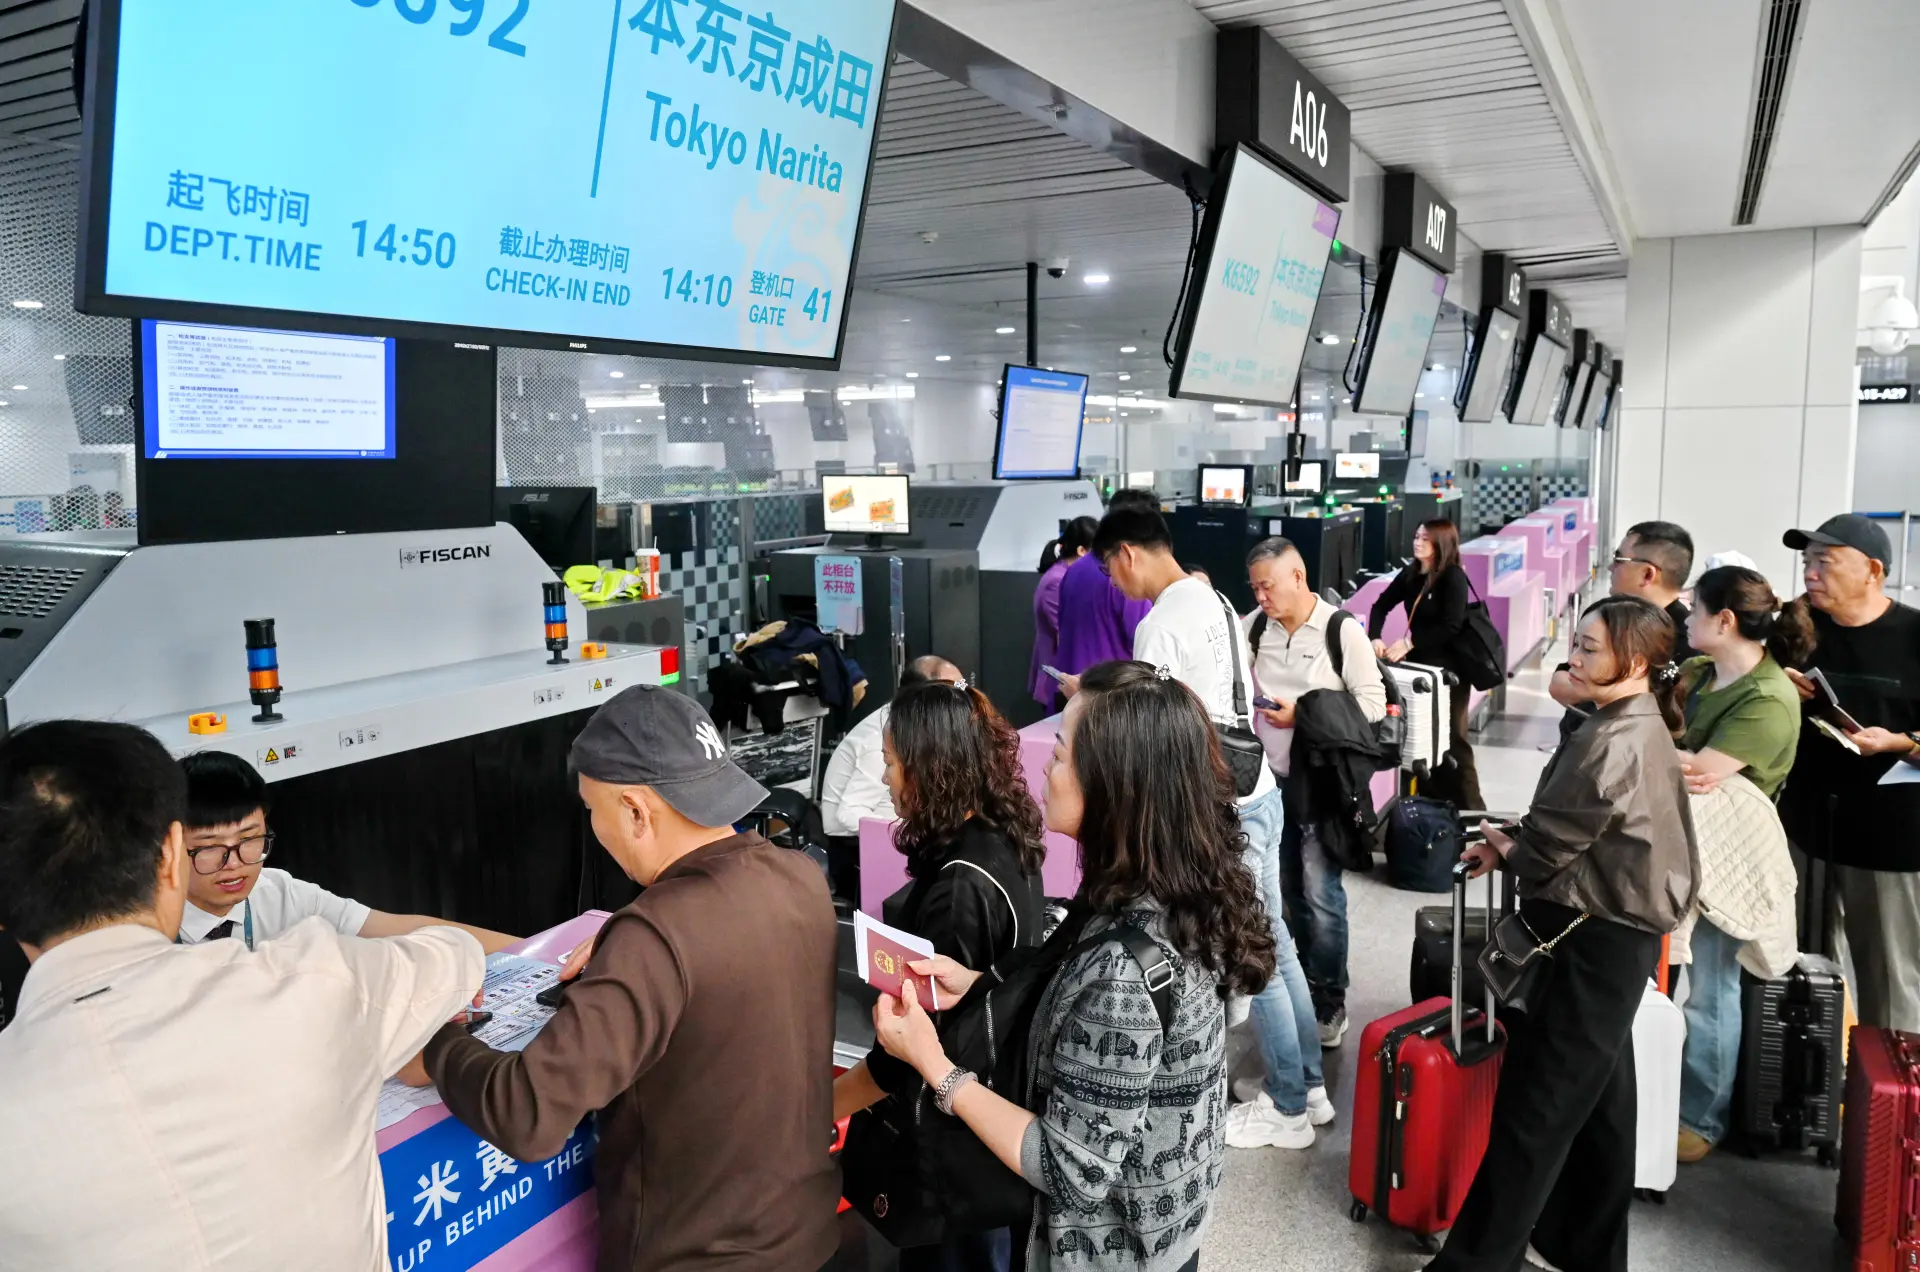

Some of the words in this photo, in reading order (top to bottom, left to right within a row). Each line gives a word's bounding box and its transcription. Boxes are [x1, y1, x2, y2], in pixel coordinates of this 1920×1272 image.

[646, 90, 747, 170] Tokyo
[756, 127, 843, 193] Narita
[1289, 79, 1329, 168] A06
[166, 169, 310, 227] 起飞时间
[144, 221, 322, 271] DEPT.TIME
[351, 219, 457, 269] 14:50
[1425, 201, 1447, 254] A07
[499, 225, 630, 274] 截止办理时间
[486, 266, 588, 302] CHECK-IN
[592, 282, 631, 307] END
[661, 266, 733, 308] 14:10
[749, 270, 795, 299] 登机口
[1222, 257, 1261, 296] K6592
[749, 304, 787, 327] GATE
[803, 286, 832, 323] 41
[522, 493, 550, 502] ASUS
[420, 545, 490, 563] FISCAN
[823, 563, 854, 578] 此柜台
[823, 580, 856, 594] 不开放
[397, 1238, 432, 1272] UP
[445, 1176, 533, 1247] BEHIND
[543, 1142, 584, 1184] THE
